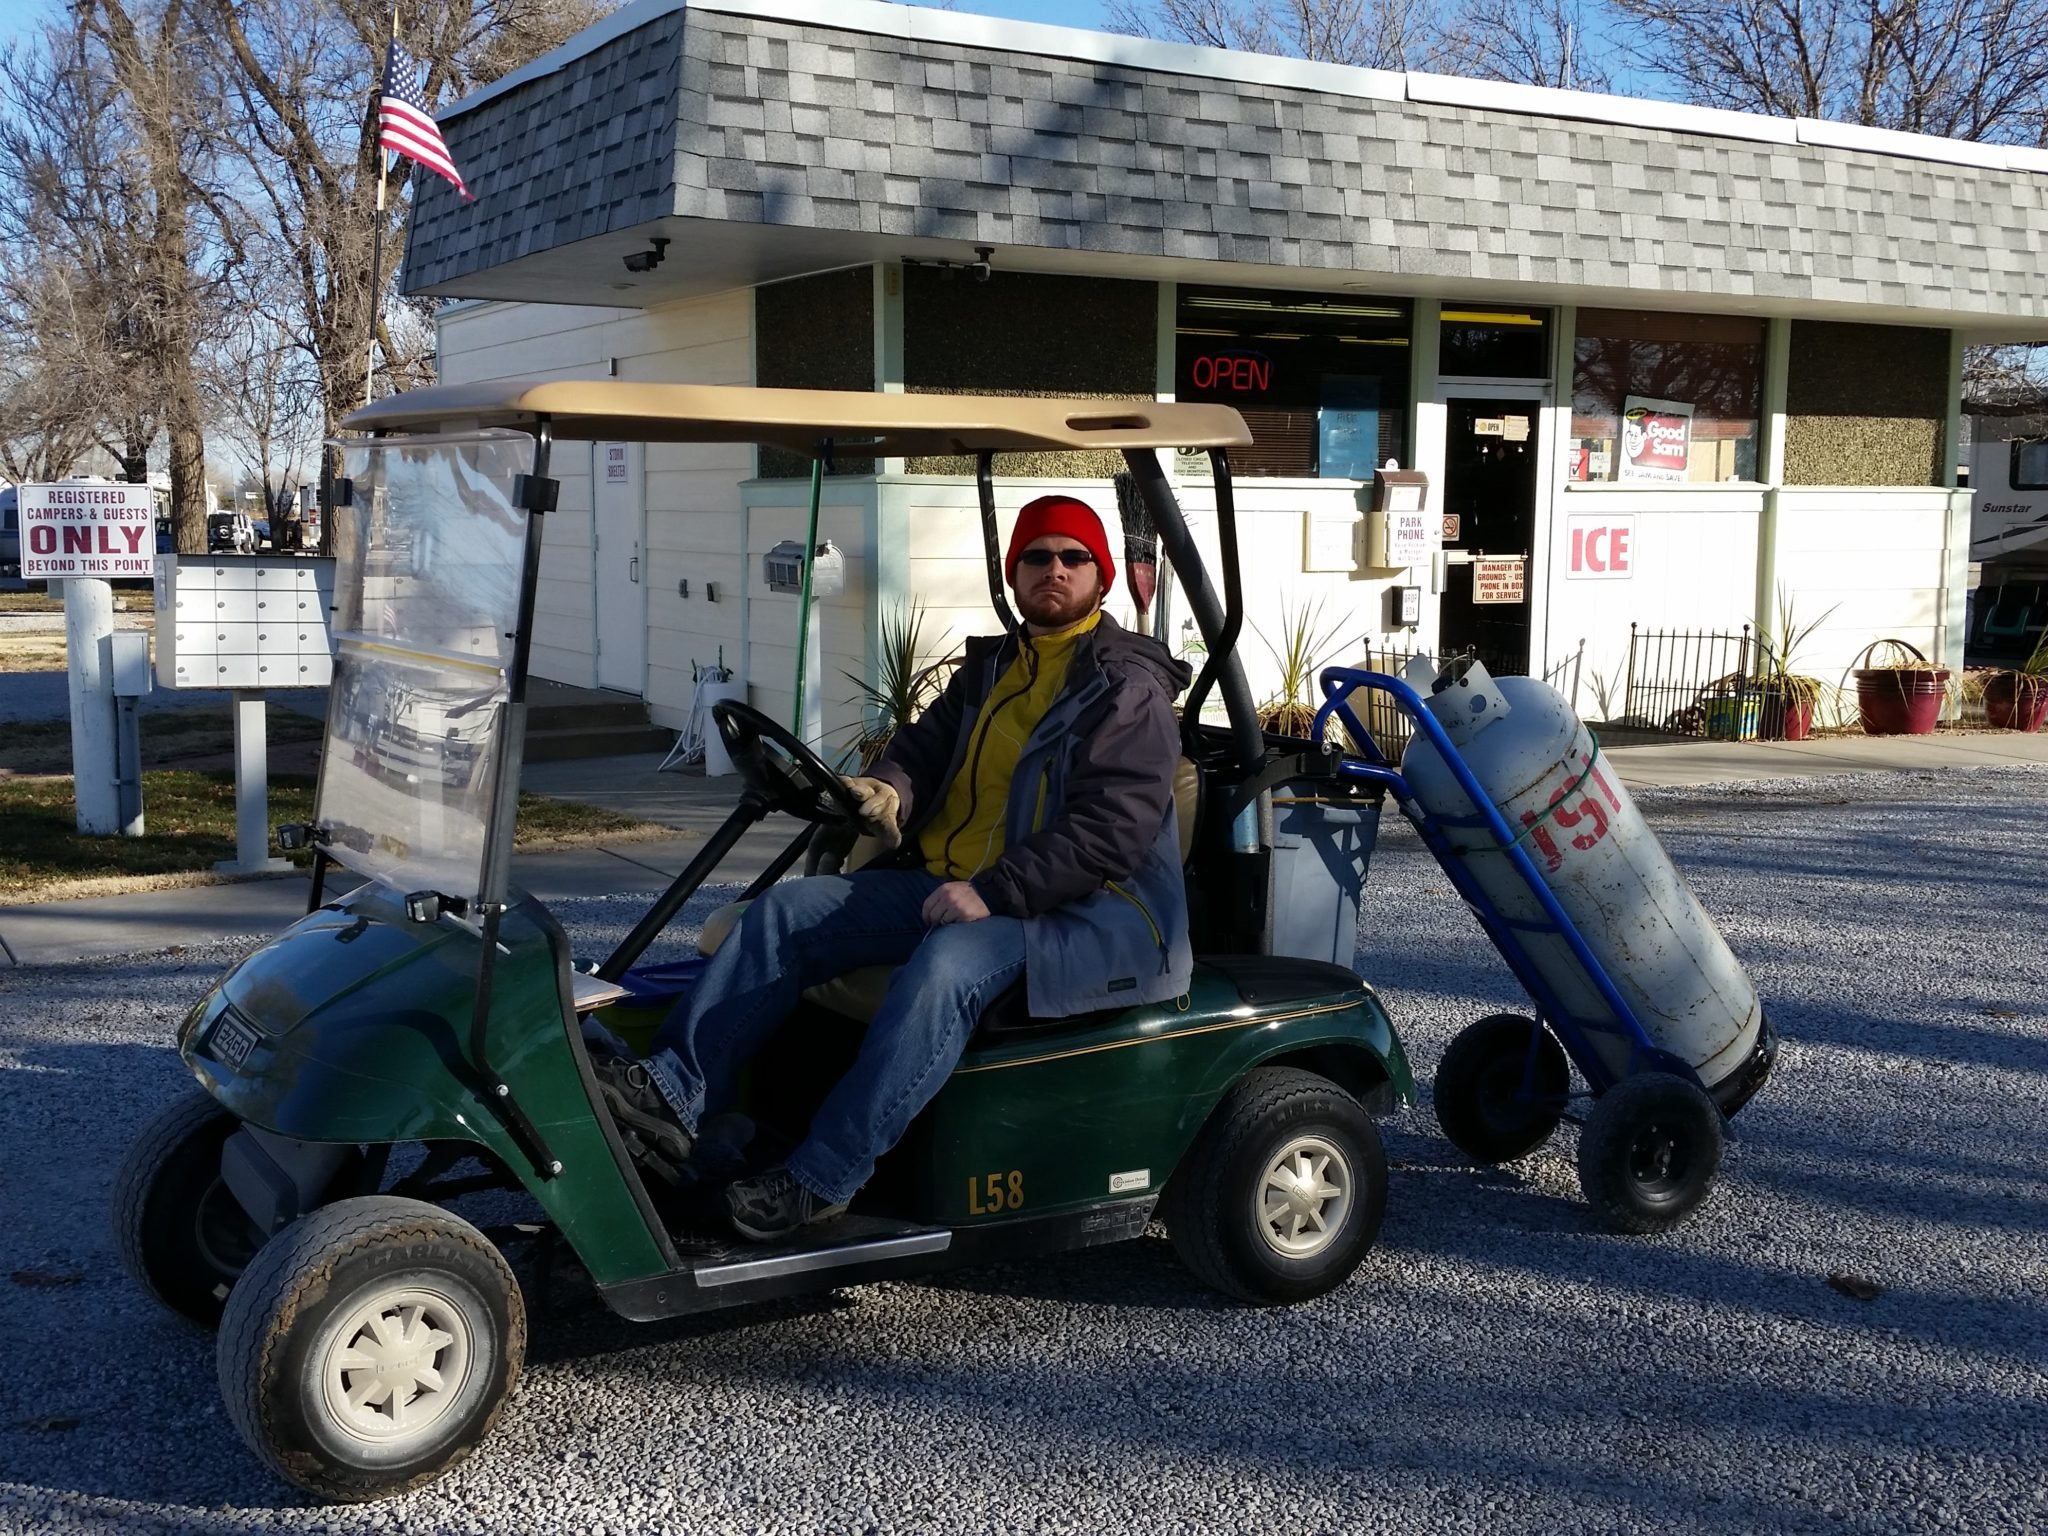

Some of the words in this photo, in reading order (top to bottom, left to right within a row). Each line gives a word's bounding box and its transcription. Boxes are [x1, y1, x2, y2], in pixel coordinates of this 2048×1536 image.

[1193, 356, 1269, 390] OPEN
[1488, 423, 1499, 431] OPEN
[1646, 421, 1685, 440] Good
[1652, 439, 1684, 457] Sam
[48, 490, 126, 504] REGISTERED
[27, 508, 83, 520] CAMPERS
[89, 508, 97, 520] &
[104, 508, 148, 520] GUESTS
[1982, 503, 2032, 513] Sunstar
[1400, 517, 1422, 527] PARK
[30, 525, 146, 554] ONLY
[1397, 529, 1425, 540] PHONE
[1571, 527, 1629, 572] ICE
[28, 560, 75, 571] BEYOND
[80, 560, 108, 570] THIS
[114, 560, 150, 571] POINT
[968, 1170, 1024, 1215] L58
